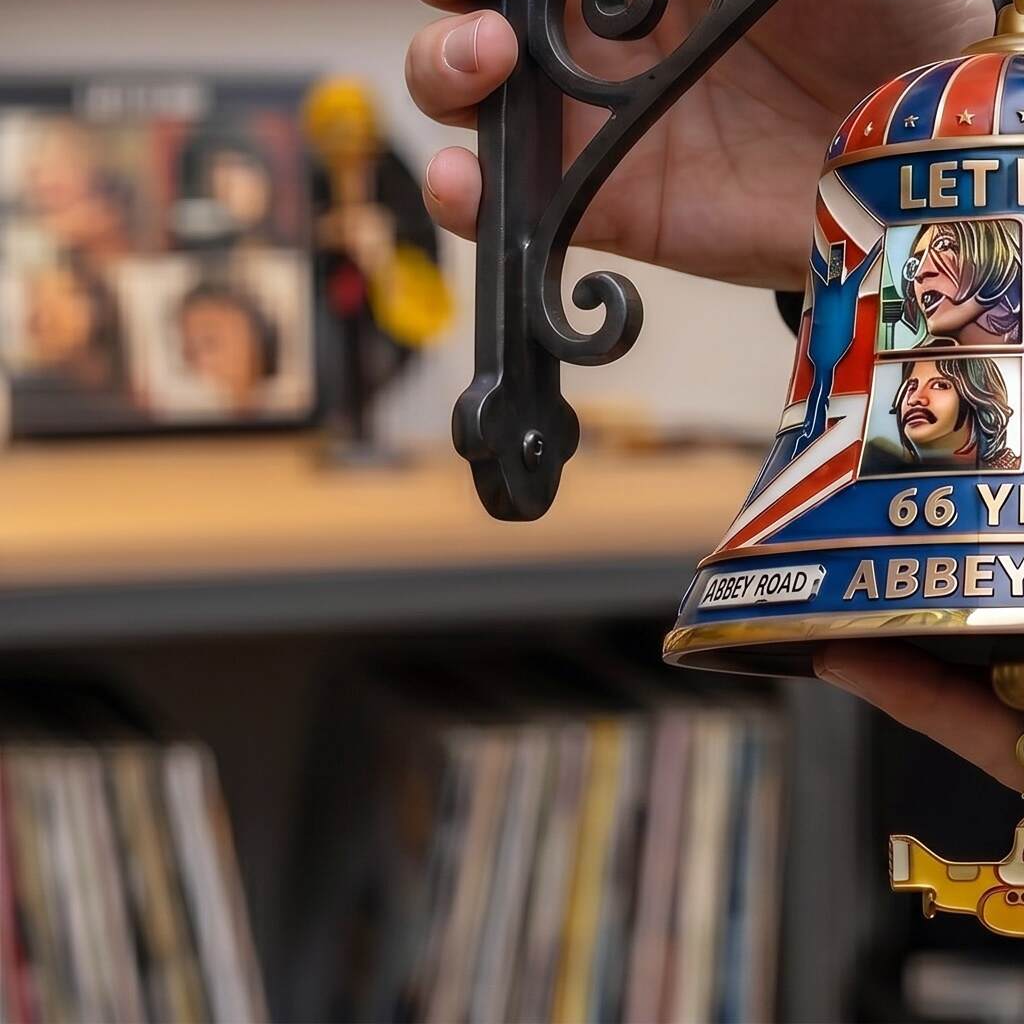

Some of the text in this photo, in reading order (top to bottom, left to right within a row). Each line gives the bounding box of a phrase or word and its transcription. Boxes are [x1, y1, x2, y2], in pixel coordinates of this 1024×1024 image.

[899, 160, 1000, 210] LET
[888, 486, 959, 528] 66
[702, 570, 808, 605] ABBEY ROAD
